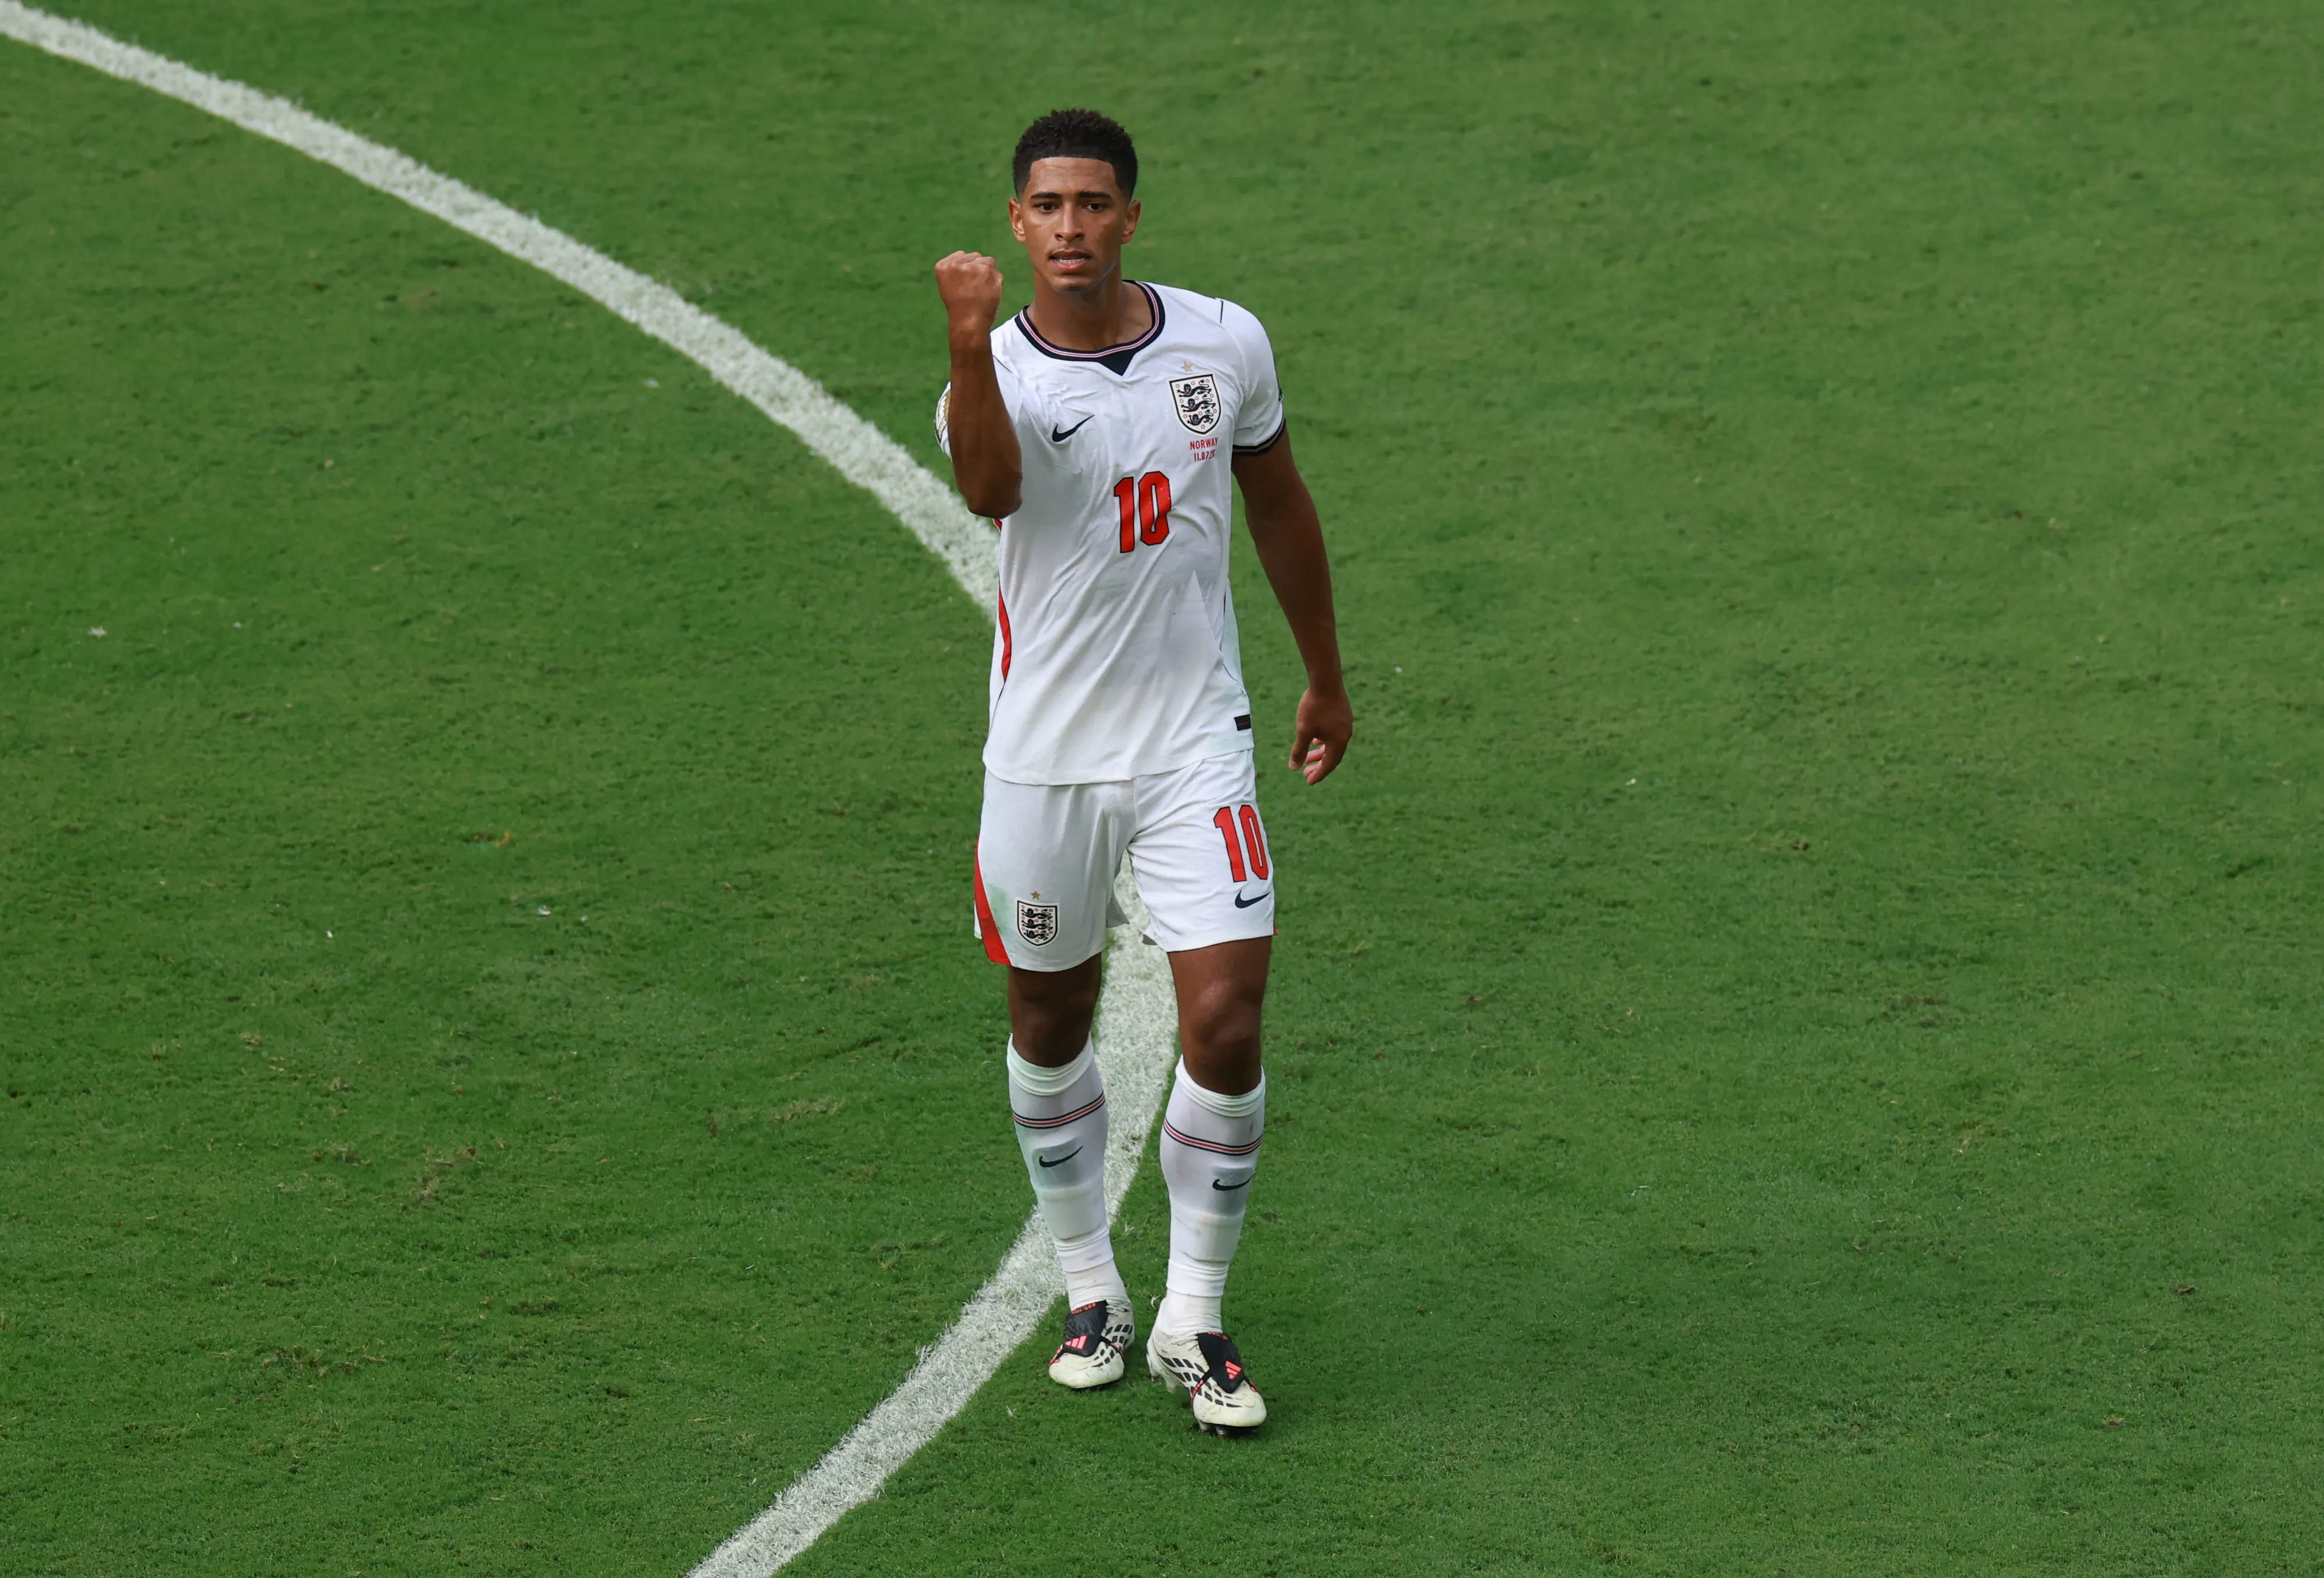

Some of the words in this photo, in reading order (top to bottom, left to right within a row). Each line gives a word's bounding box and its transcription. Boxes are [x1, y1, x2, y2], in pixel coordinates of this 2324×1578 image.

[1190, 437, 1219, 450] NORWAY
[1114, 471, 1172, 553] 10
[1213, 805, 1268, 883] 10
